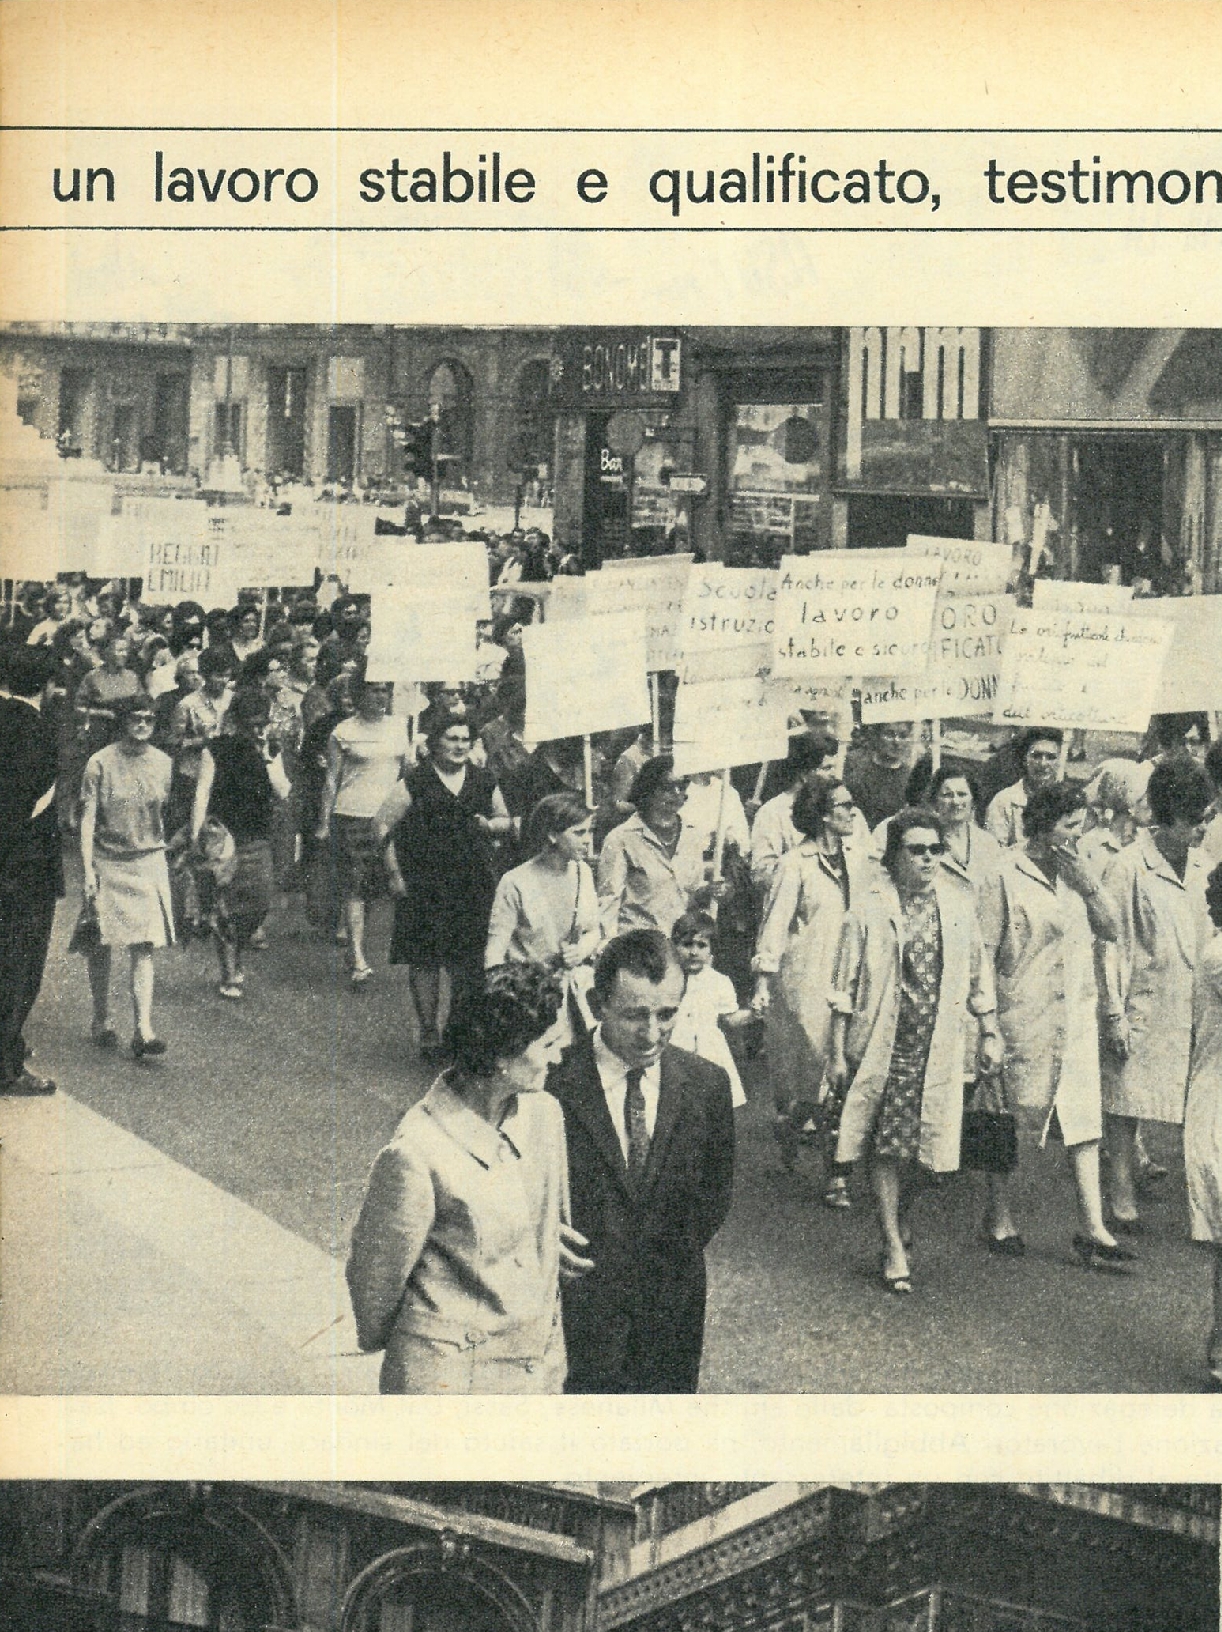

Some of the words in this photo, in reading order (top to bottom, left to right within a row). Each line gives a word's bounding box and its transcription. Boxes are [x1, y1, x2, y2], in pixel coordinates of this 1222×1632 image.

[53, 167, 115, 202] un
[155, 151, 318, 203] lavoro
[359, 151, 536, 203] stabile
[577, 168, 608, 203] e
[649, 152, 941, 217] qualificato,
[800, 601, 899, 624] lavoro
[778, 637, 846, 659] stabile
